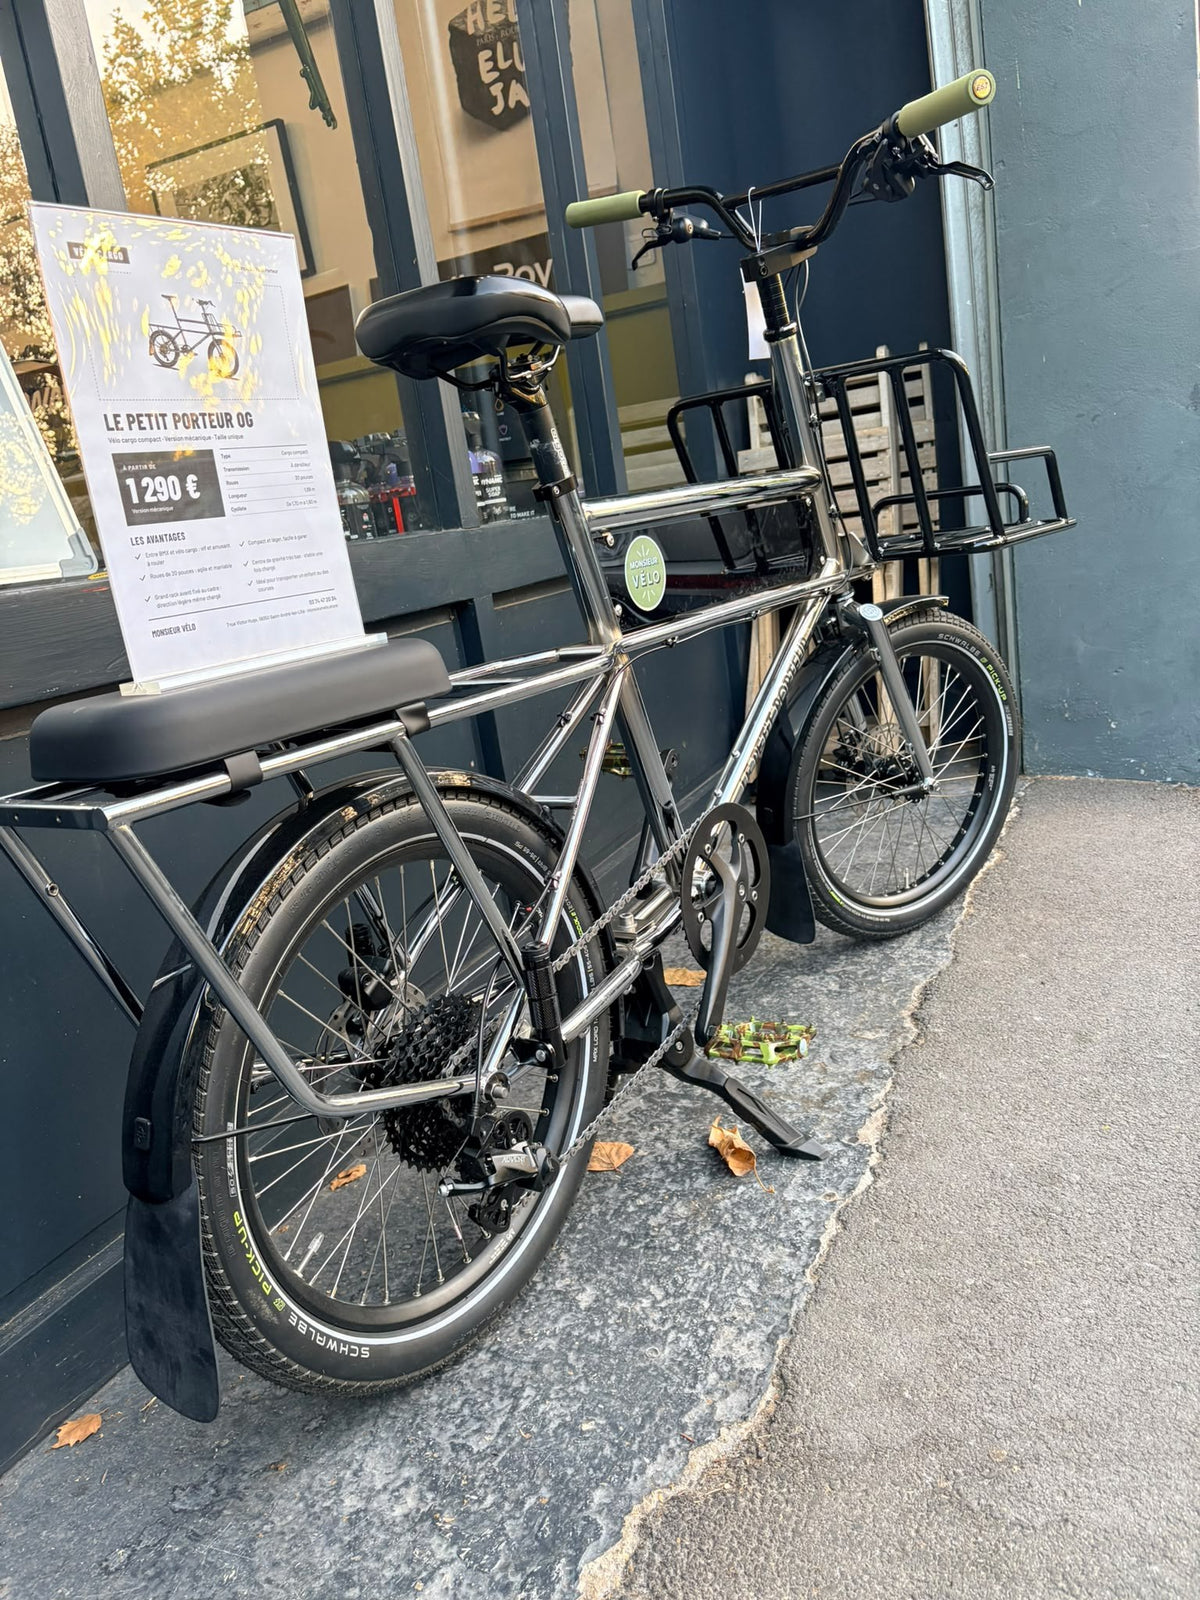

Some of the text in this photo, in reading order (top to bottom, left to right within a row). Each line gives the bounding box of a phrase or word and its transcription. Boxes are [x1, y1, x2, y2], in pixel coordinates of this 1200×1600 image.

[466, 0, 518, 35] HEL
[489, 79, 531, 115] JA
[104, 411, 254, 431] LE PETIT PORTEUR OG
[184, 434, 212, 442] mécanique
[126, 474, 200, 504] 1 290 €
[150, 506, 174, 514] mécanique
[130, 532, 186, 546] LES AVANTAGES
[630, 556, 658, 570] MONSIEUR
[632, 570, 661, 589] VÉLO
[152, 622, 197, 638] MONSIEUR VÉLO
[937, 633, 982, 658] SCHWALBE
[986, 664, 1007, 701] PICK-UP
[233, 1210, 272, 1296] PICK-UP
[288, 1312, 370, 1358] SCHWALBE
